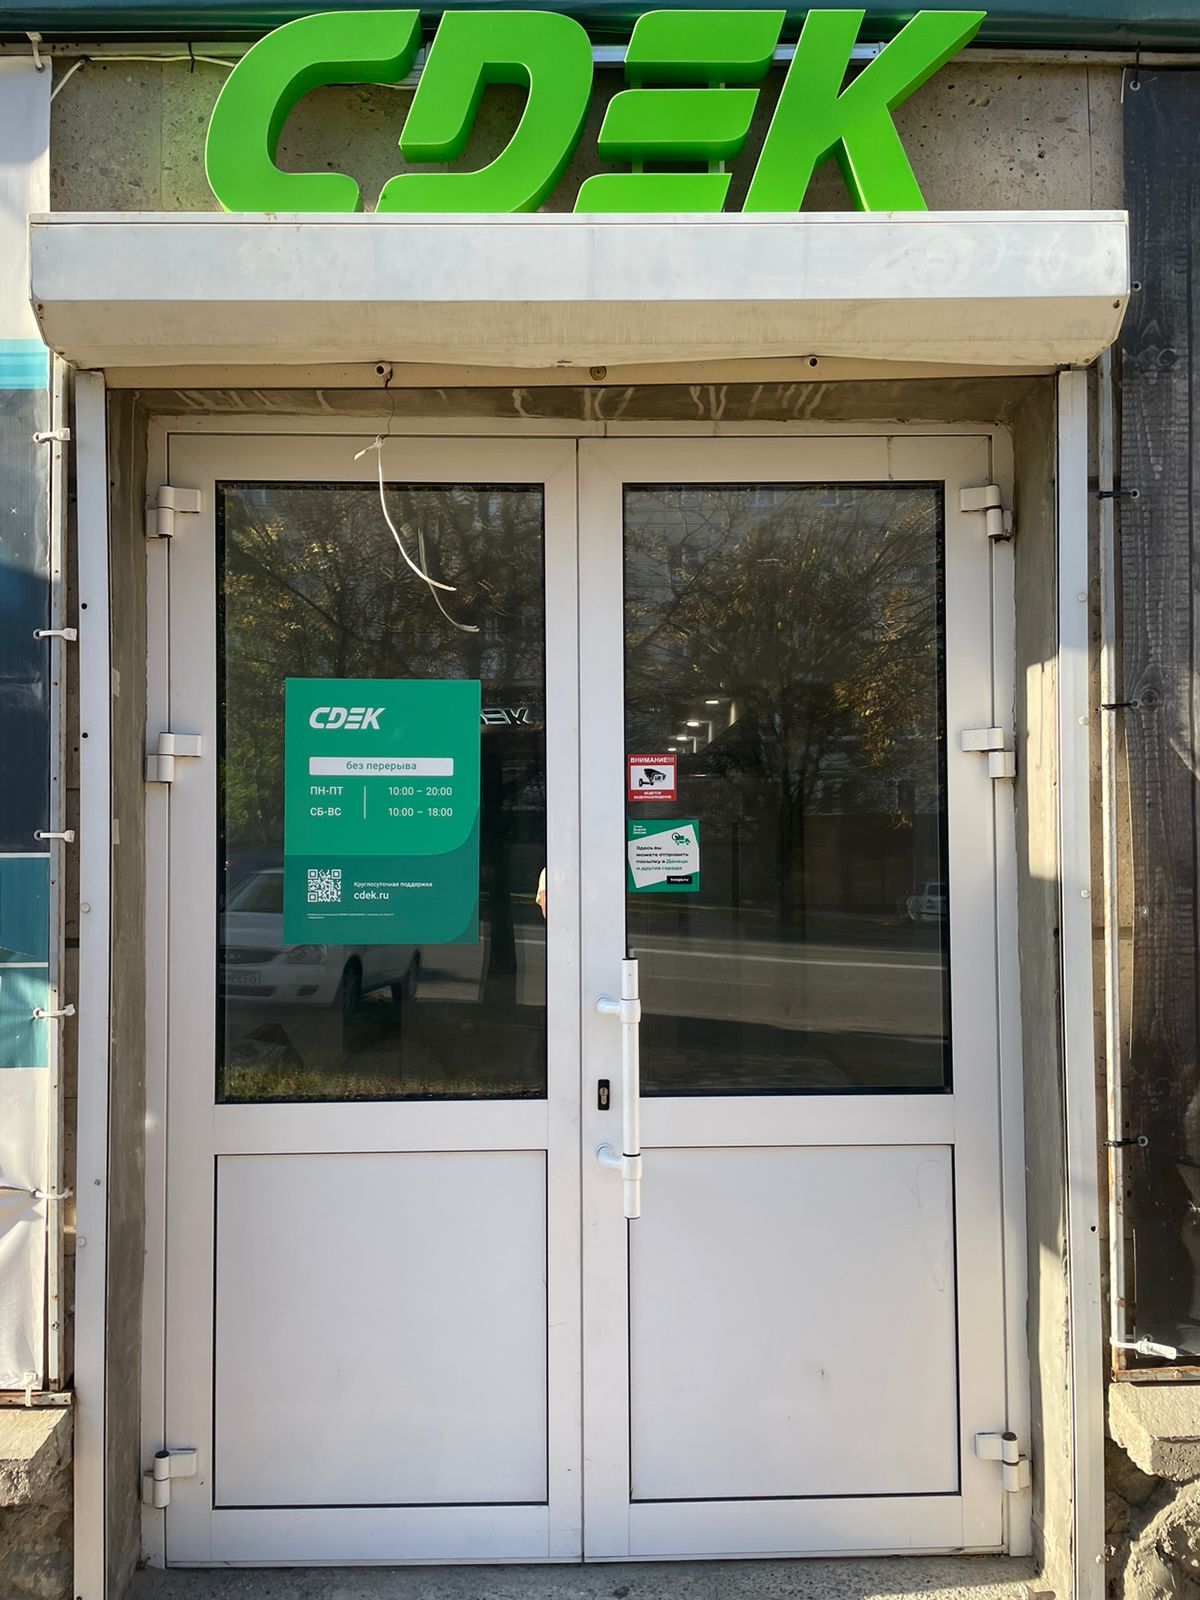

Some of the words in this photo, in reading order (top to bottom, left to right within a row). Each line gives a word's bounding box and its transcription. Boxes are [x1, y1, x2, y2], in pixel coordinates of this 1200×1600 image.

[204, 9, 987, 213] CDEK
[309, 706, 386, 730] CDEK
[346, 761, 364, 770] без
[366, 763, 417, 772] перерыва
[310, 786, 344, 796] ПН-ПТ
[388, 786, 414, 796] 10:00
[426, 786, 453, 796] 20:00
[310, 807, 342, 817] СБ-ВС
[388, 807, 414, 817] 10:00
[428, 807, 453, 817] 18:00
[353, 890, 389, 900] cdek.ru
